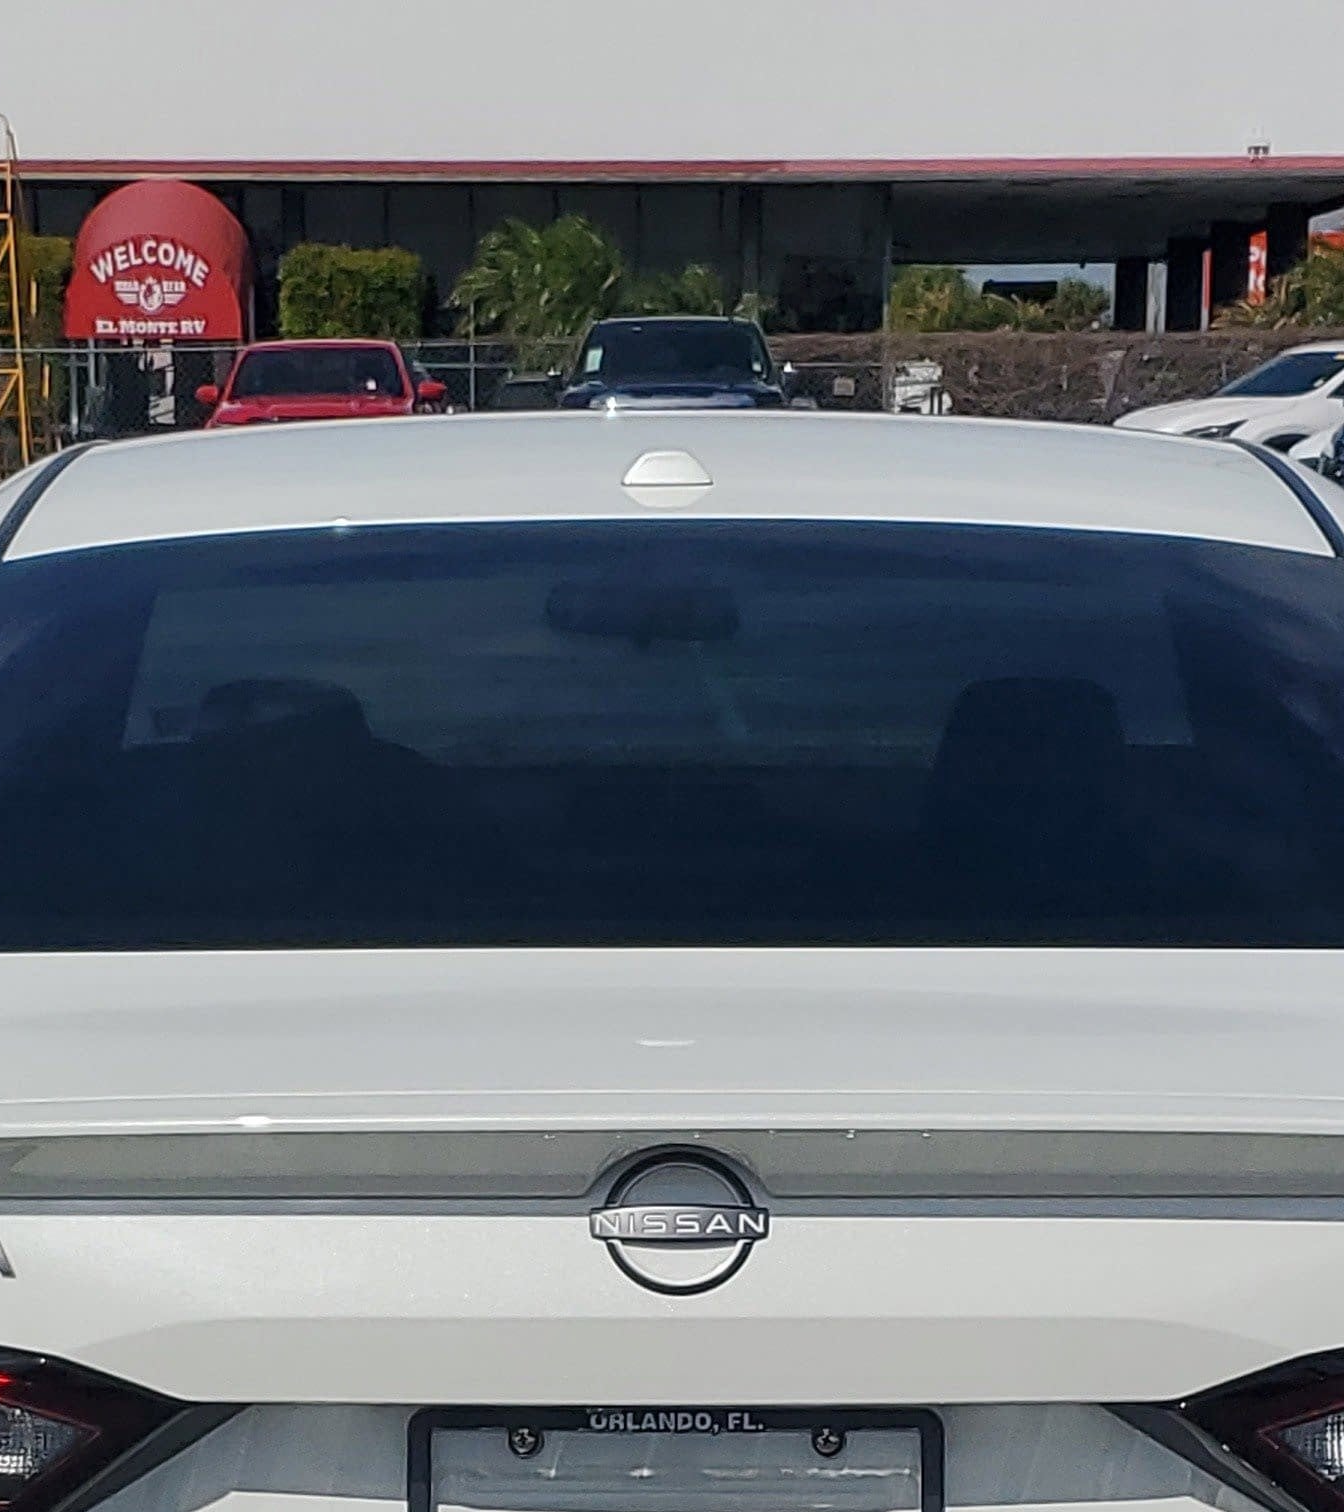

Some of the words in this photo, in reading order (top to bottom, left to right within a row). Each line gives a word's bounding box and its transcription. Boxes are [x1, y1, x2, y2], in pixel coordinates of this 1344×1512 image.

[89, 239, 210, 289] WELCOME
[95, 319, 117, 334] EL
[119, 319, 178, 335] MONTE
[179, 319, 206, 335] RV
[594, 1212, 766, 1235] NISSAN
[589, 1409, 720, 1436] ORLANDO,
[727, 1411, 765, 1431] FL.
